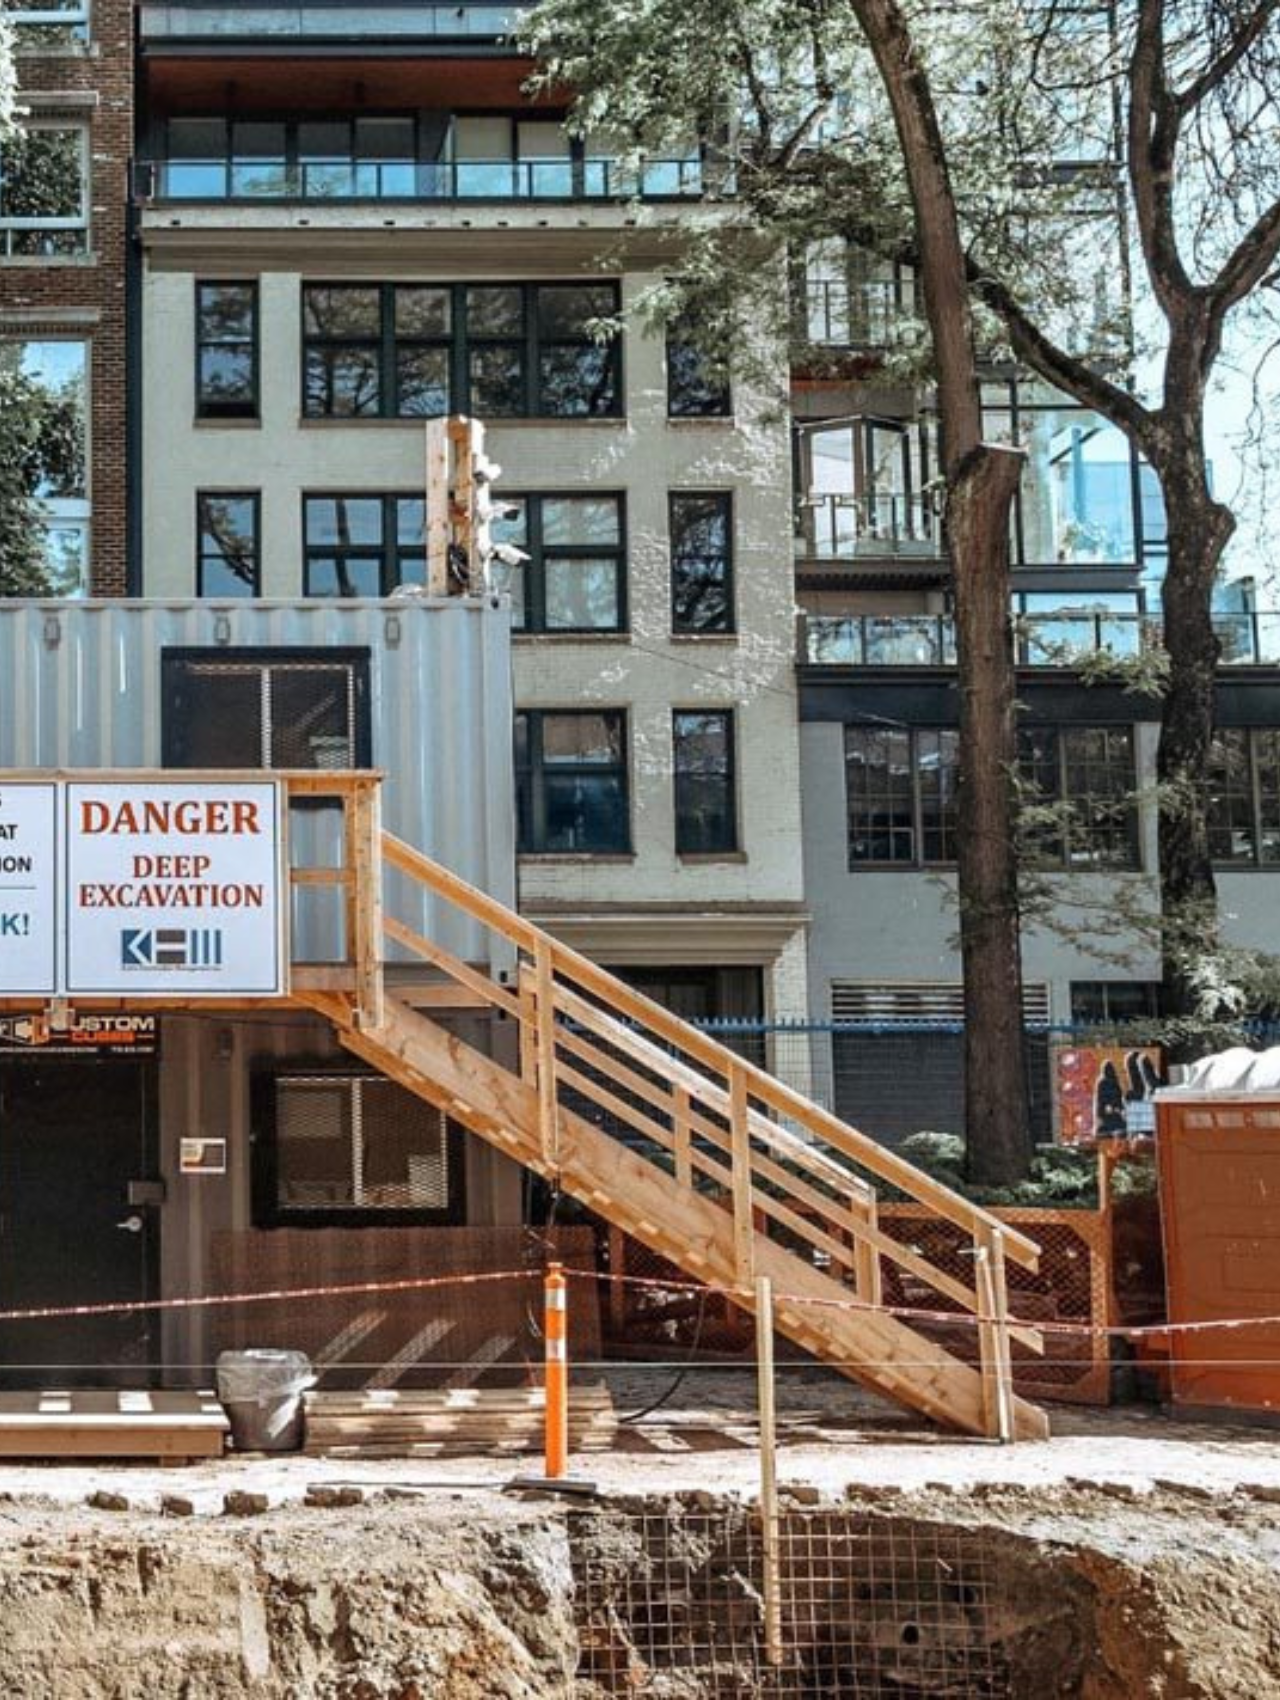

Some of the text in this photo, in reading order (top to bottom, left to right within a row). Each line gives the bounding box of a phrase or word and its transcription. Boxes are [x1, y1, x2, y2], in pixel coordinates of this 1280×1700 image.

[80, 801, 260, 834] DANGER
[133, 855, 211, 878] DEEP
[79, 884, 264, 907] EXCAVATION
[70, 1016, 155, 1031] USTOM
